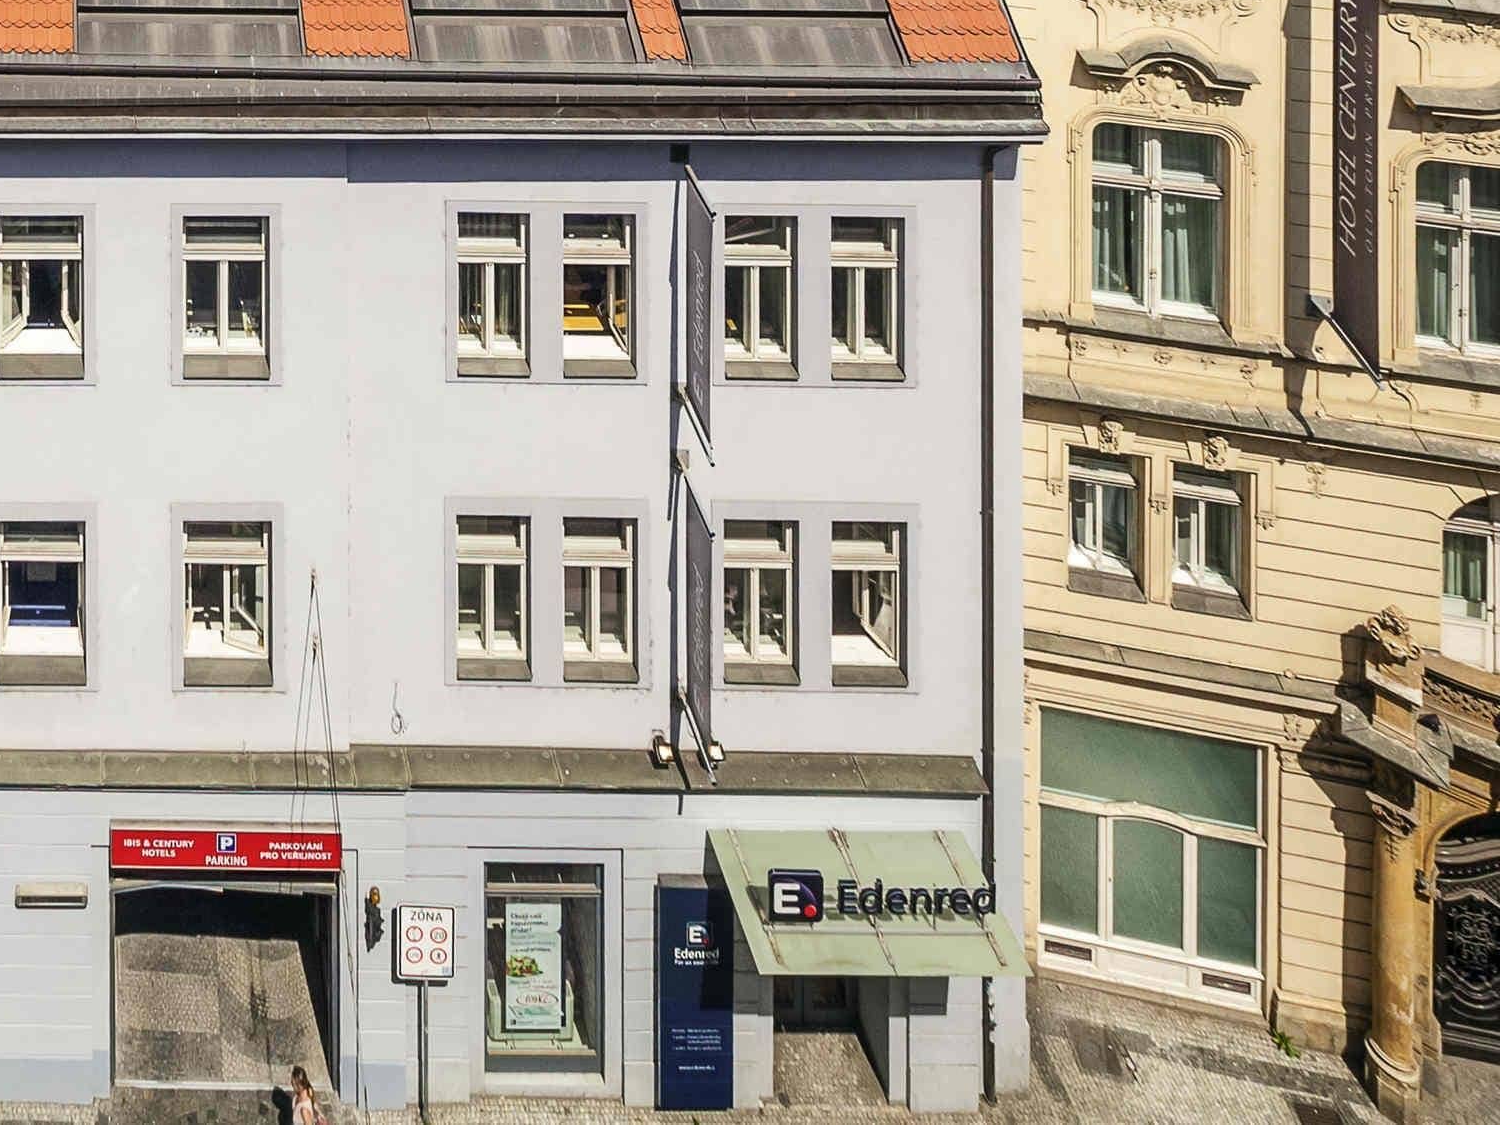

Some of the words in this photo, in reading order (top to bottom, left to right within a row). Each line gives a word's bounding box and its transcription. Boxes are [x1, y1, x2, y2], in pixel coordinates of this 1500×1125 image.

[1338, 148, 1357, 258] HOTEL
[123, 838, 141, 847] IBIS
[152, 839, 195, 849] CENTURY
[219, 836, 235, 851] P
[268, 841, 324, 851] PARKOVÁNÍ
[141, 849, 176, 858] HOTELS
[259, 851, 279, 860] PRO
[205, 855, 248, 867] PARKING
[838, 878, 997, 915] Edenred
[410, 909, 443, 923] ZÓNA
[674, 947, 719, 960] Edenred
